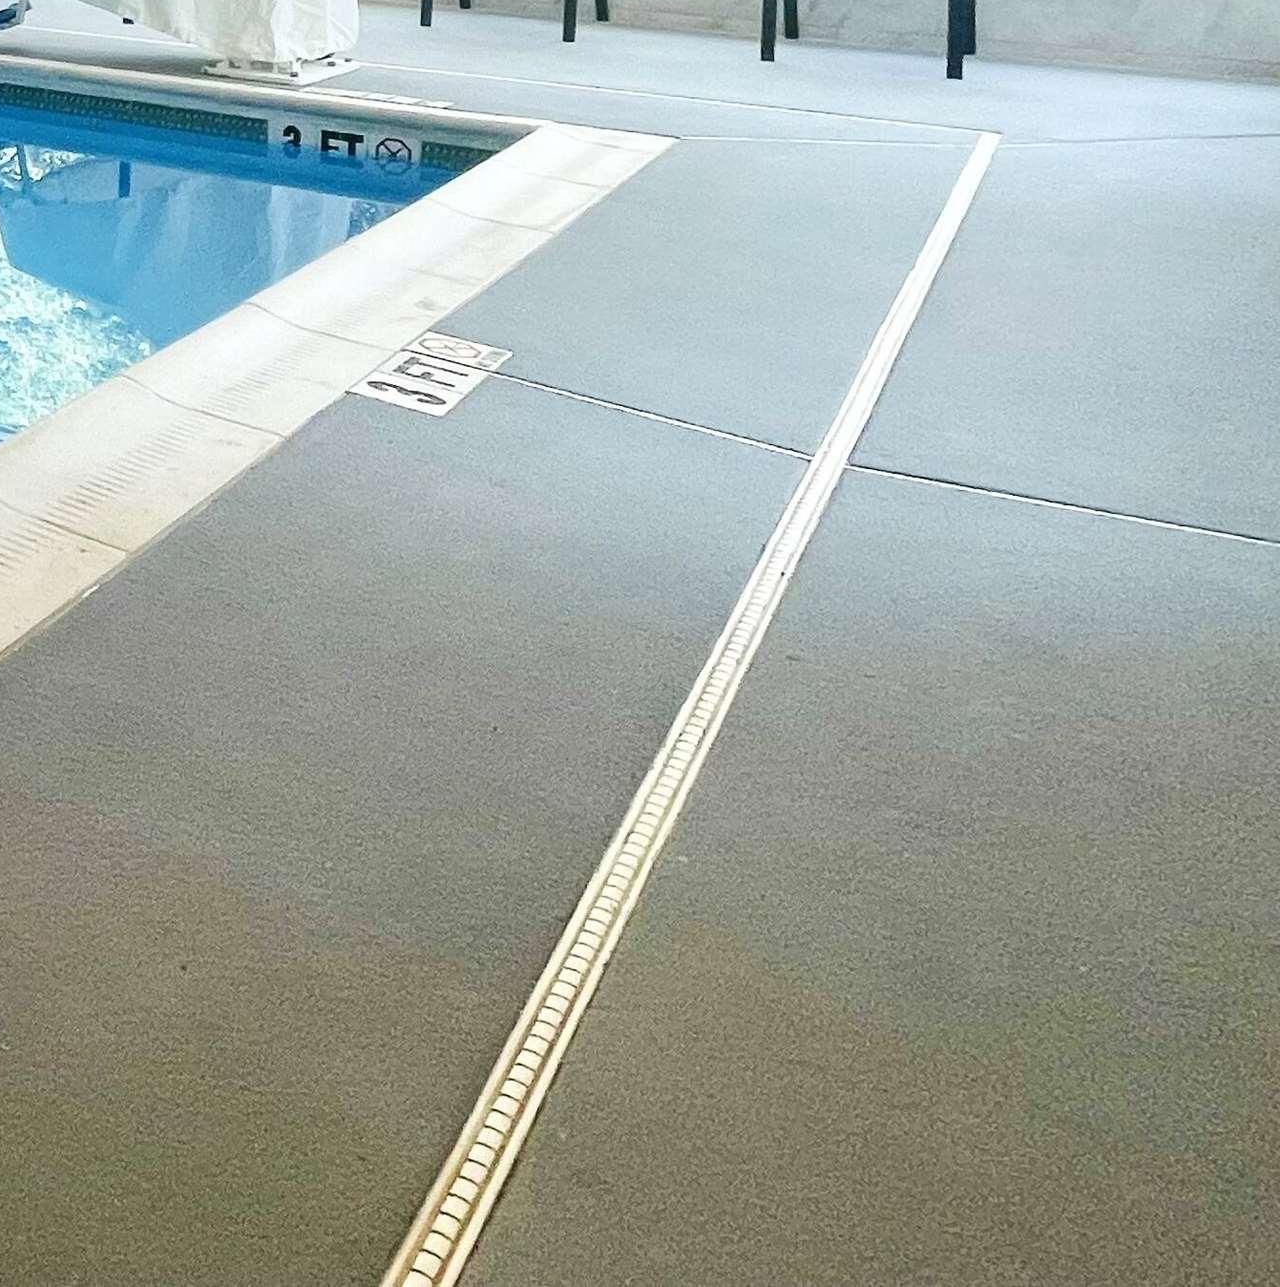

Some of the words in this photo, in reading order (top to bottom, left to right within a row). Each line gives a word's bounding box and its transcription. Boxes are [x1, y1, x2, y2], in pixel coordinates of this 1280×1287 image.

[321, 129, 364, 157] FT
[393, 356, 468, 388] FT
[367, 381, 446, 405] 3
